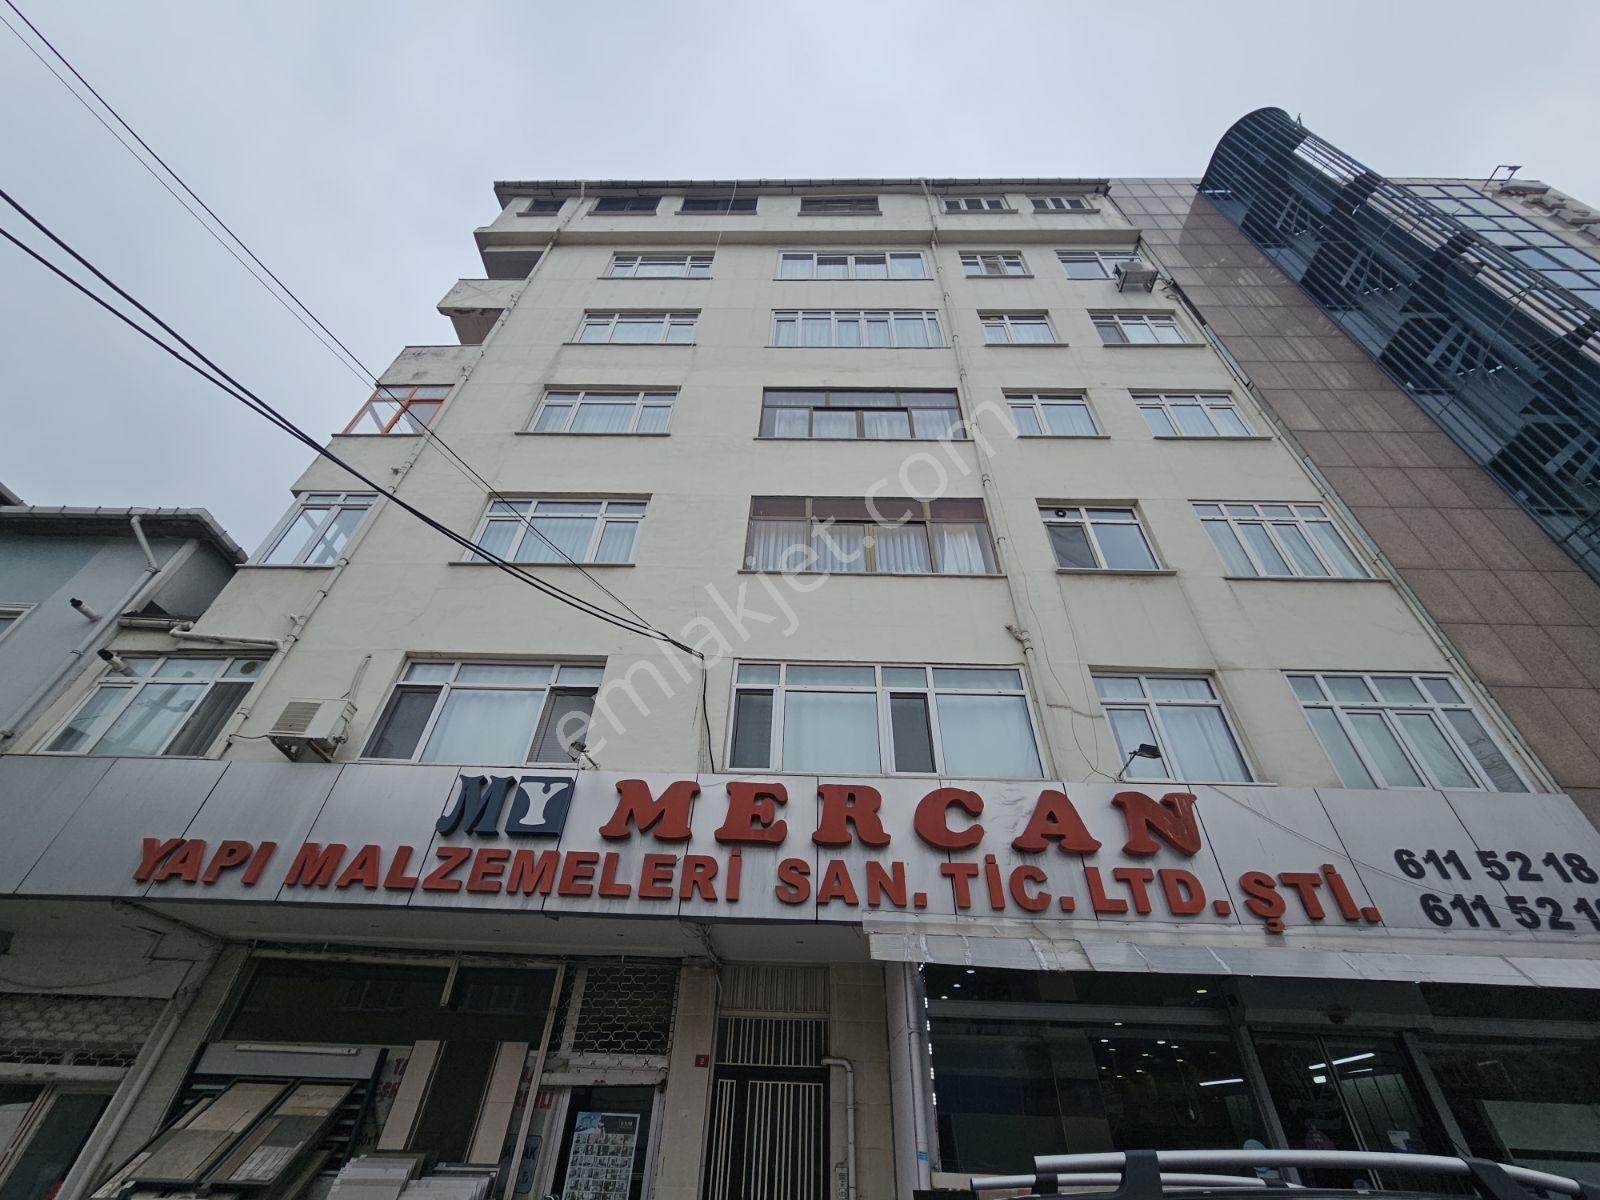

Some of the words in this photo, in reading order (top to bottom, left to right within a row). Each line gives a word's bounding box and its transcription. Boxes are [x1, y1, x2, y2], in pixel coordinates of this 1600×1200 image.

[436, 774, 572, 837] MY
[599, 778, 1201, 857] MERCAN
[132, 838, 277, 885] YAPI
[284, 842, 741, 902] MALZEMELERİ
[775, 857, 927, 908] SAN.
[1239, 863, 1383, 935] ŞTİ.
[1394, 849, 1472, 880] 611
[1475, 850, 1544, 882] 52
[1542, 852, 1599, 884] 18
[1419, 893, 1501, 928] 611
[1504, 895, 1576, 929] 52
[1573, 897, 1600, 931] 1
